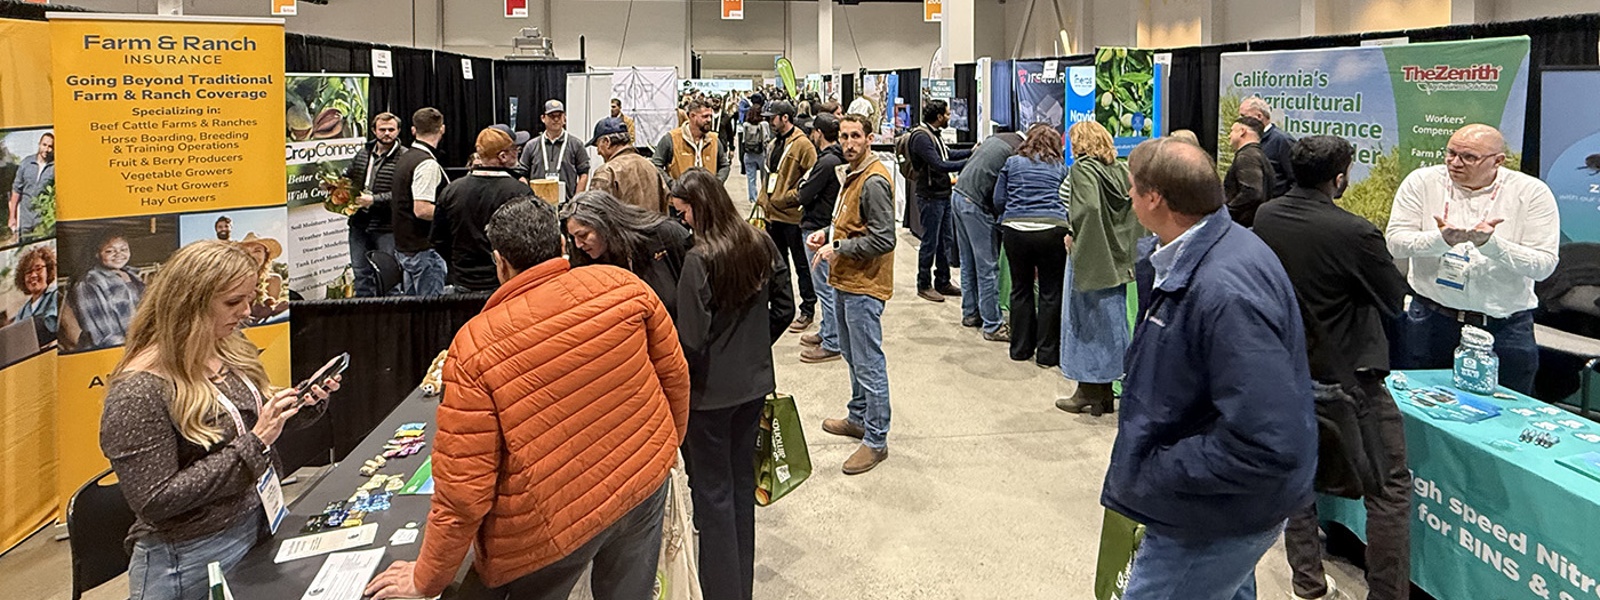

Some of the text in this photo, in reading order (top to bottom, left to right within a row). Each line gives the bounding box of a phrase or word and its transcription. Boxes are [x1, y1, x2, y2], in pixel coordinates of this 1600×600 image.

[84, 34, 256, 50] Farm & Ranch
[124, 55, 222, 64] INSURANCE
[1234, 70, 1328, 87] California's
[1403, 65, 1498, 80] TheZenith
[66, 74, 272, 88] Going Beyond Traditional
[74, 89, 267, 100] Farm & Ranch Coverage
[1254, 93, 1361, 112] gricultural
[132, 106, 221, 117] Specializing in:
[90, 118, 257, 131] Beef Cattle Farms & Ranches
[1284, 116, 1382, 139] Insurance
[1412, 125, 1457, 136] Compens
[101, 131, 249, 144] Horse Boarding, Breeding
[113, 141, 239, 154] & Training Operations
[1411, 148, 1434, 158] Farm
[109, 154, 243, 167] Fruit & Berry Producers
[121, 168, 233, 181] Vegetable Growers
[288, 174, 313, 184] Better
[126, 181, 229, 193] Tree Nut Growers
[141, 194, 216, 206] Hay Growers
[287, 189, 309, 201] With
[1449, 497, 1527, 555] speed
[1418, 503, 1549, 600] for BINS &
